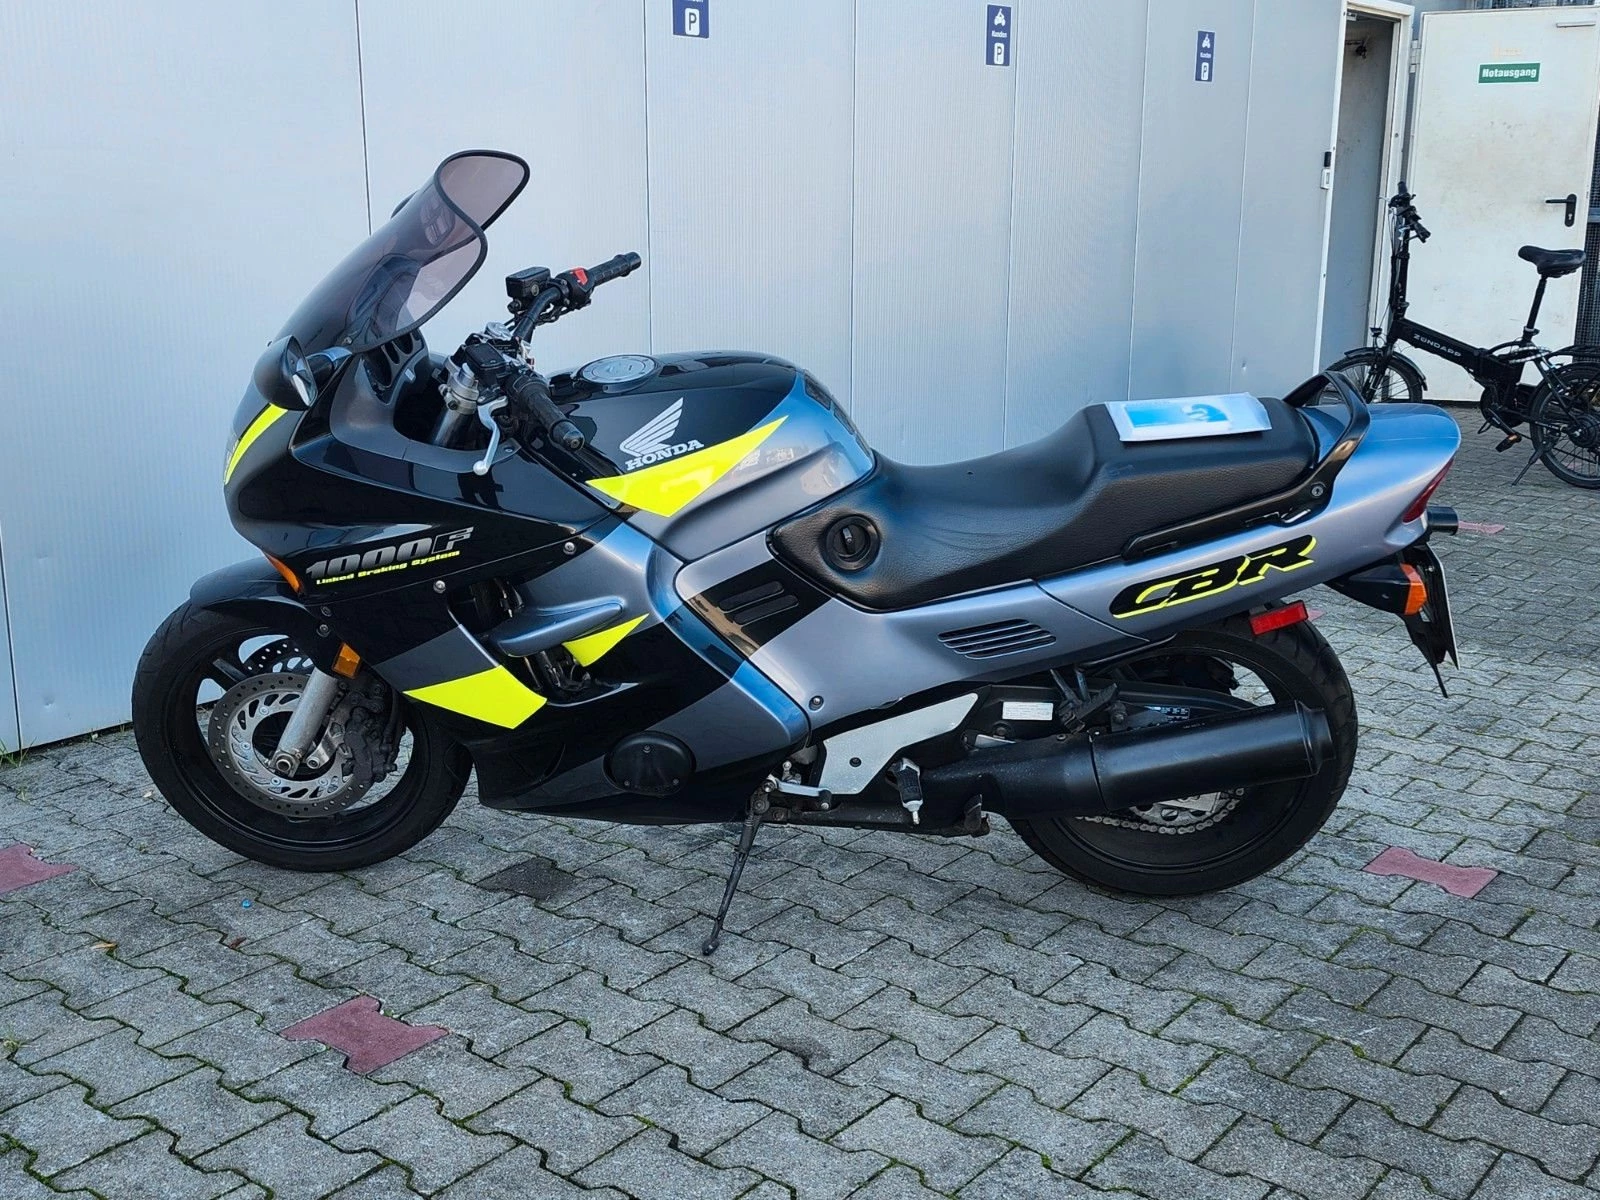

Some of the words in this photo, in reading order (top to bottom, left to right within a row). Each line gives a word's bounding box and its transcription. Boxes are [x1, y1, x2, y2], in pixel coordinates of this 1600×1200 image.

[689, 12, 697, 31] P
[996, 45, 1003, 62] P
[1482, 68, 1537, 79] Notausgang
[625, 439, 704, 471] HONDA
[316, 573, 355, 585] Linked
[357, 562, 408, 578] Braking
[411, 550, 461, 566] System
[1109, 534, 1317, 619] CBR
